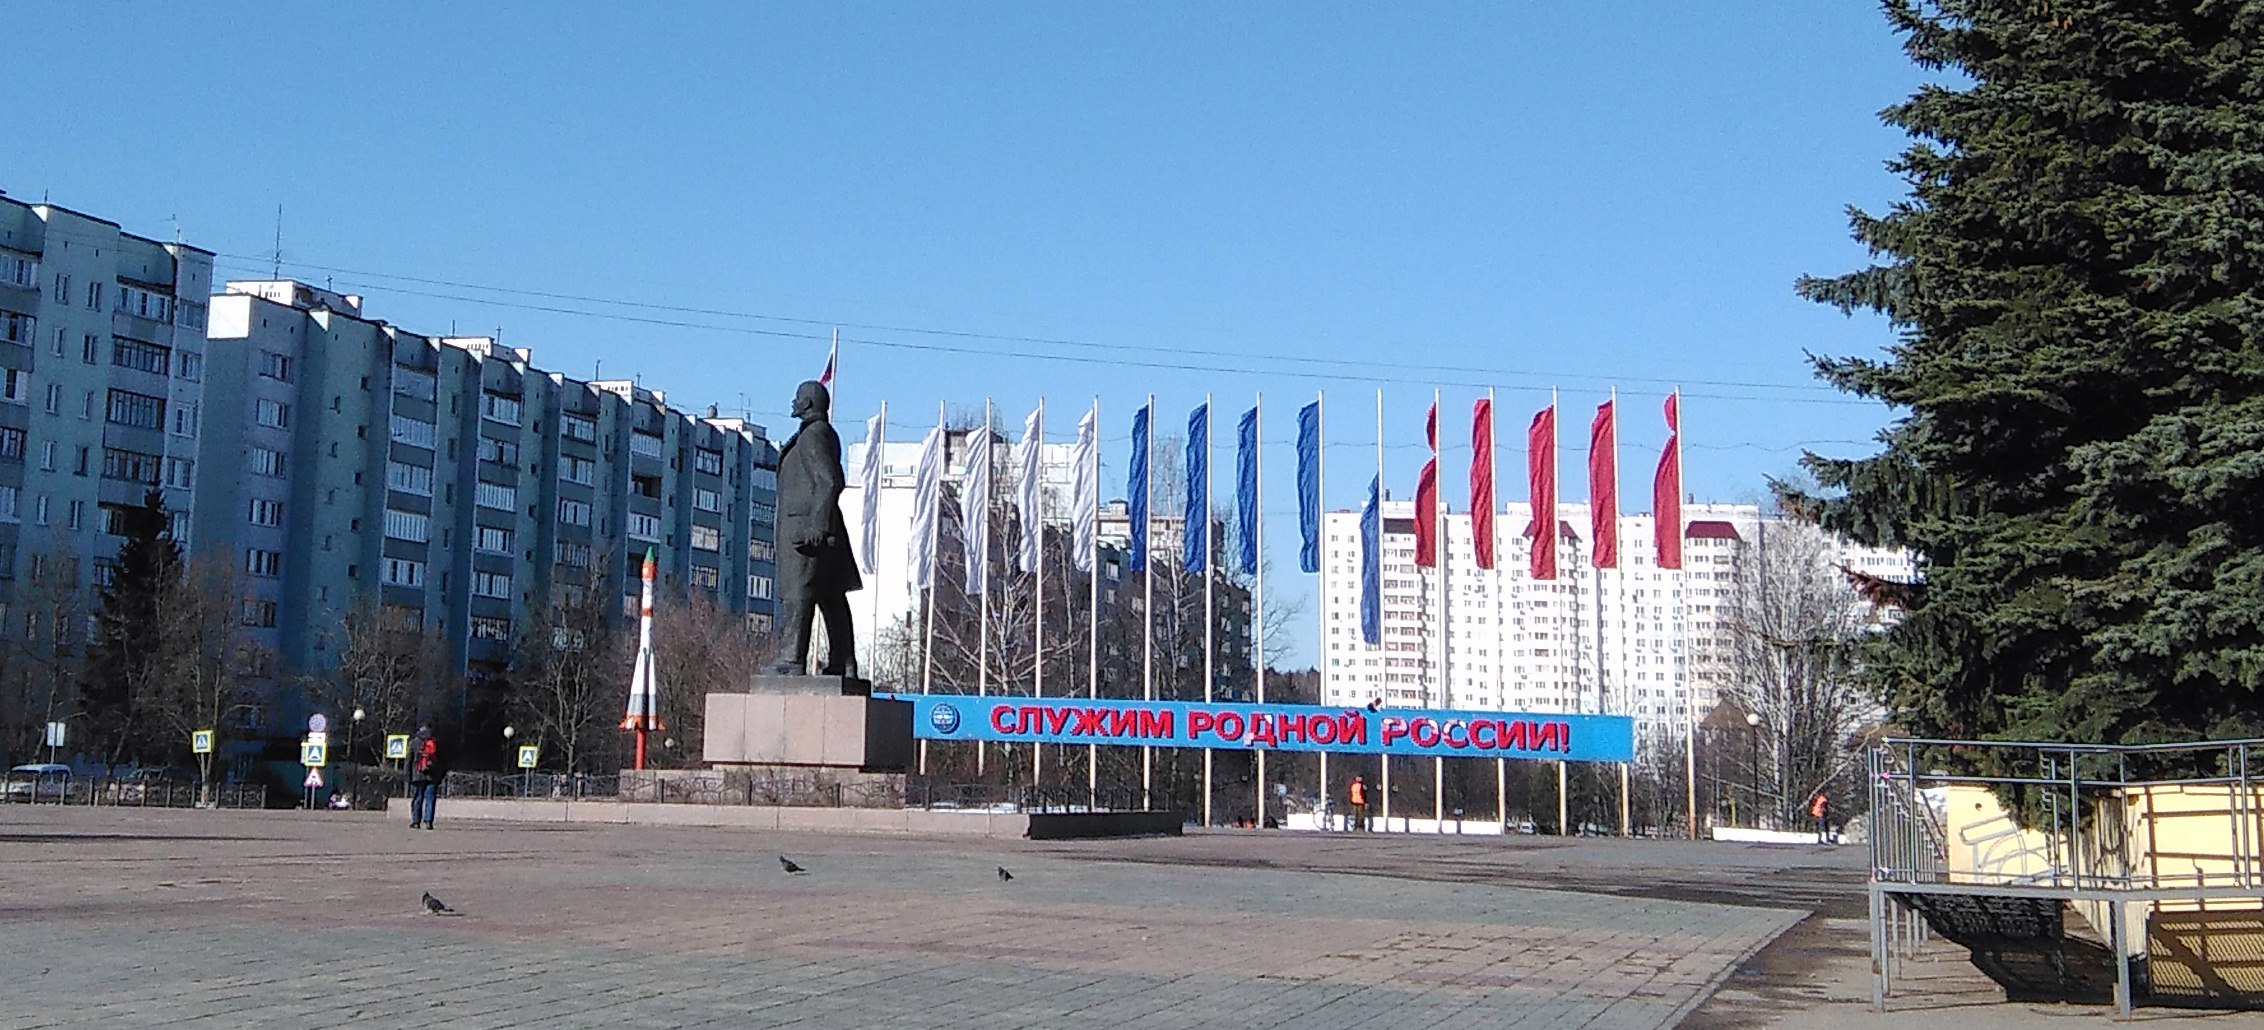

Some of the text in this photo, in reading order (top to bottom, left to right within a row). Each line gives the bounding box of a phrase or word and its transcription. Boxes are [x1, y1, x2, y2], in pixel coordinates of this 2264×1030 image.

[990, 705, 1571, 753] СЛУЖИМ РОДНОЙ РОССИИ!
